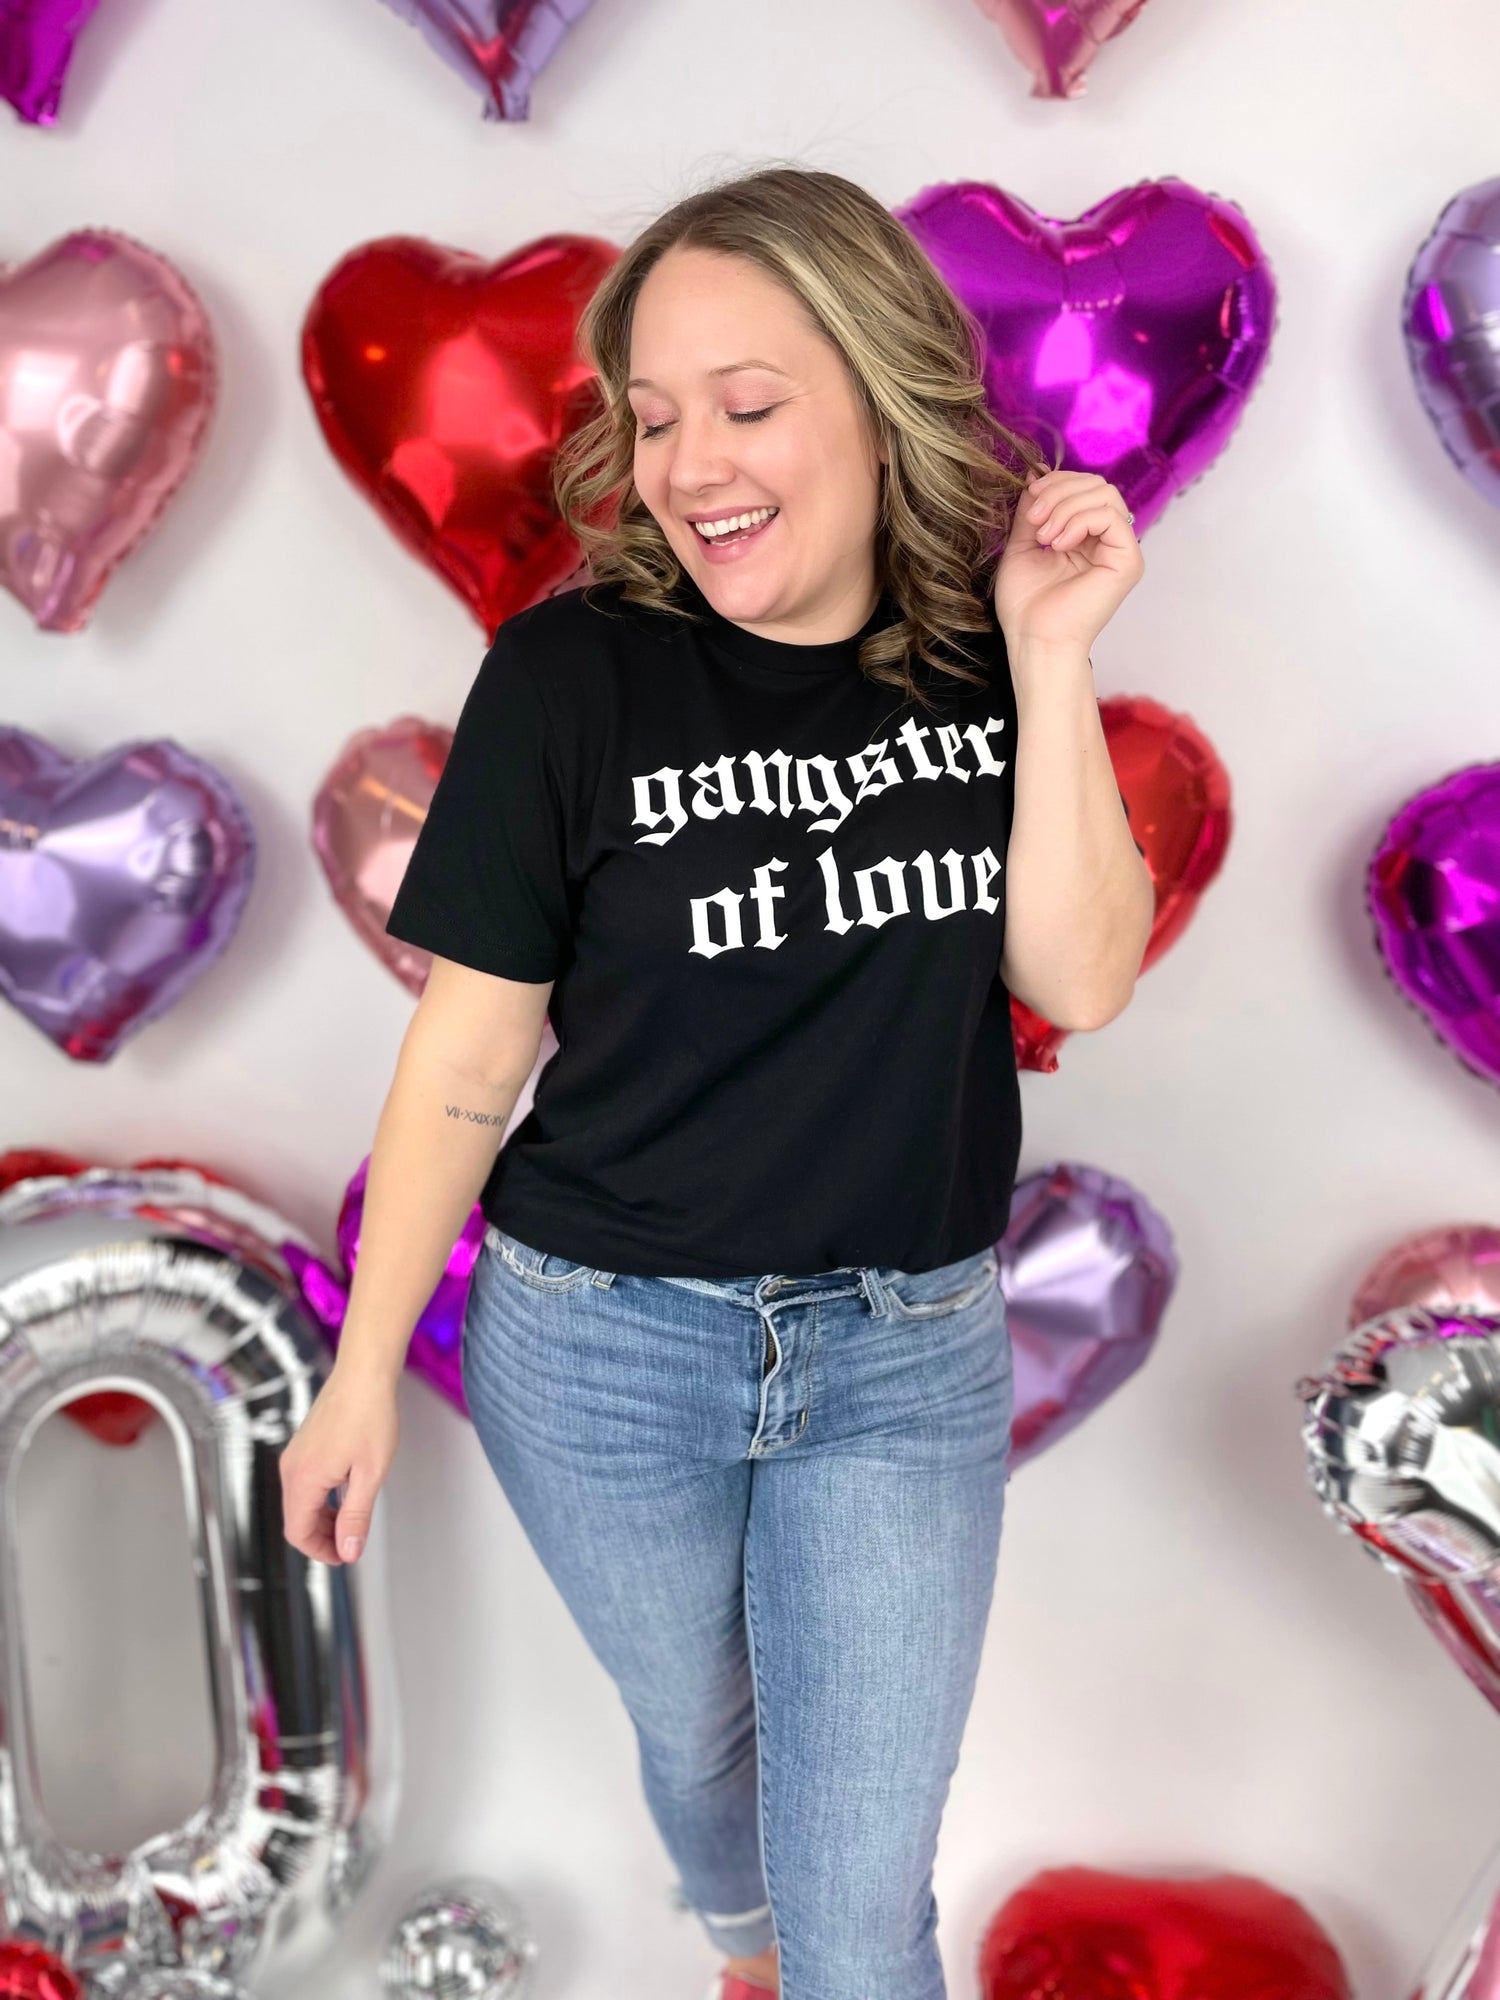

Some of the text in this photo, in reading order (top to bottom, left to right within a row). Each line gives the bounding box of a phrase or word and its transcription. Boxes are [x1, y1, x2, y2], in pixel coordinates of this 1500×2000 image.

[631, 716, 1007, 847] gangster
[688, 846, 1002, 960] of love
